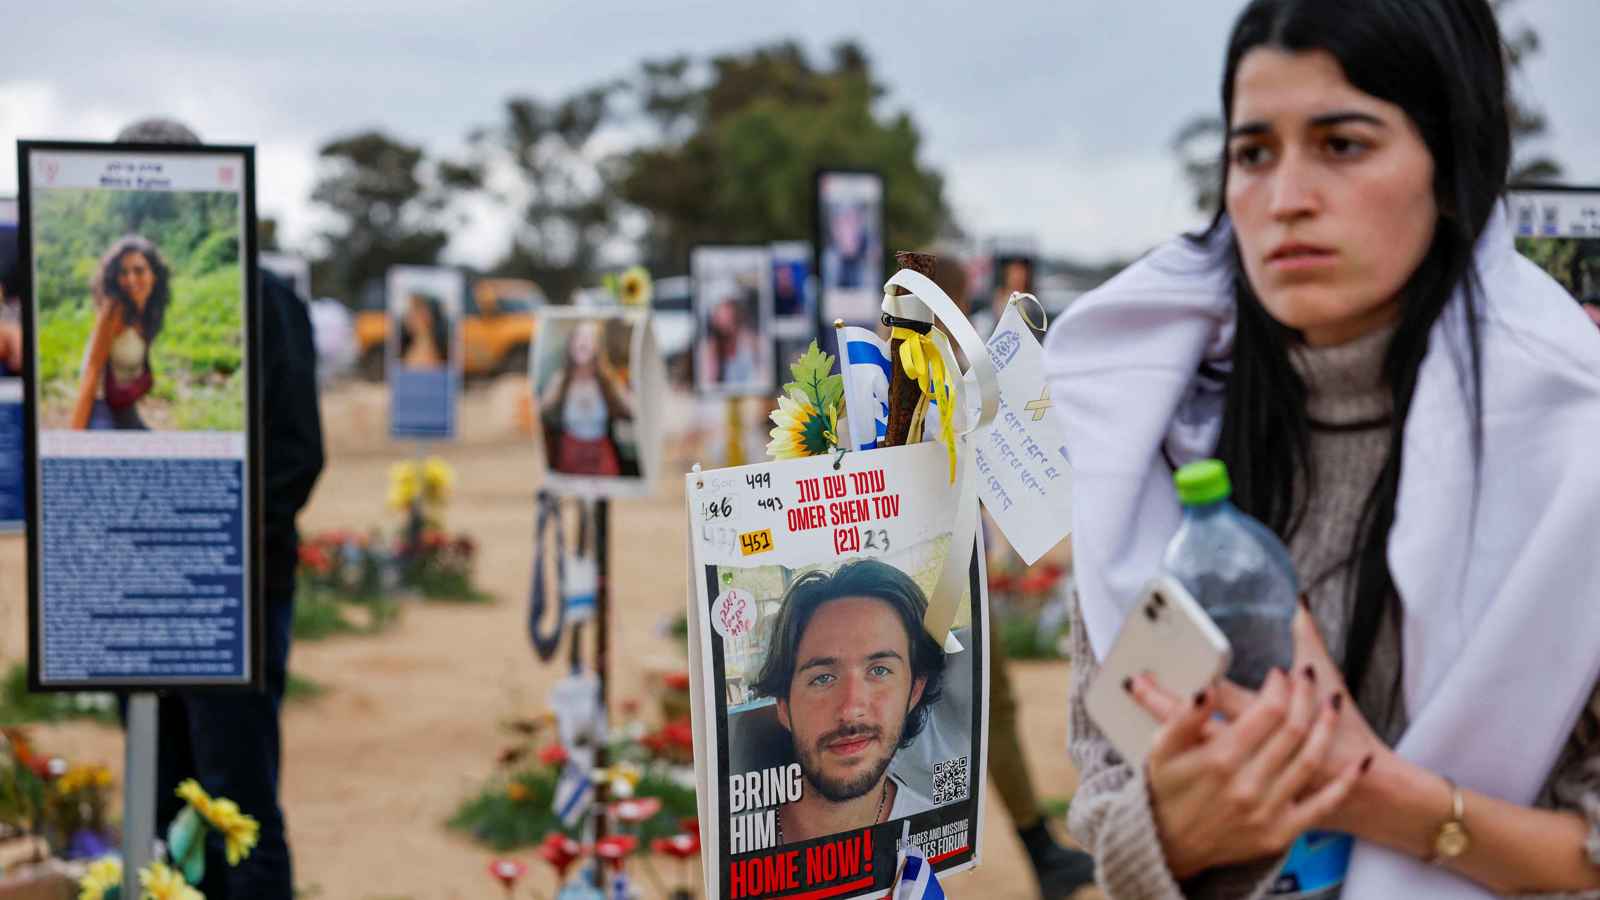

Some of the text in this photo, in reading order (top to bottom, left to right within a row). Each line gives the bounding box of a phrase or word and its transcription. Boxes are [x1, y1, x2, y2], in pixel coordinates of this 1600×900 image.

[745, 472, 771, 489] 499
[796, 469, 886, 503] עומר שם טוב
[757, 496, 784, 512] 493
[787, 494, 900, 532] OMER SHEM TOV
[833, 526, 860, 555] (21)
[864, 530, 890, 551] 23
[729, 762, 802, 812] BRING
[730, 810, 776, 854] HIM
[896, 830, 929, 851] HSTAGES
[929, 826, 942, 841] AND
[942, 818, 969, 837] MISSING
[938, 830, 968, 856] FORUM
[730, 829, 874, 899] HOME NOW!
